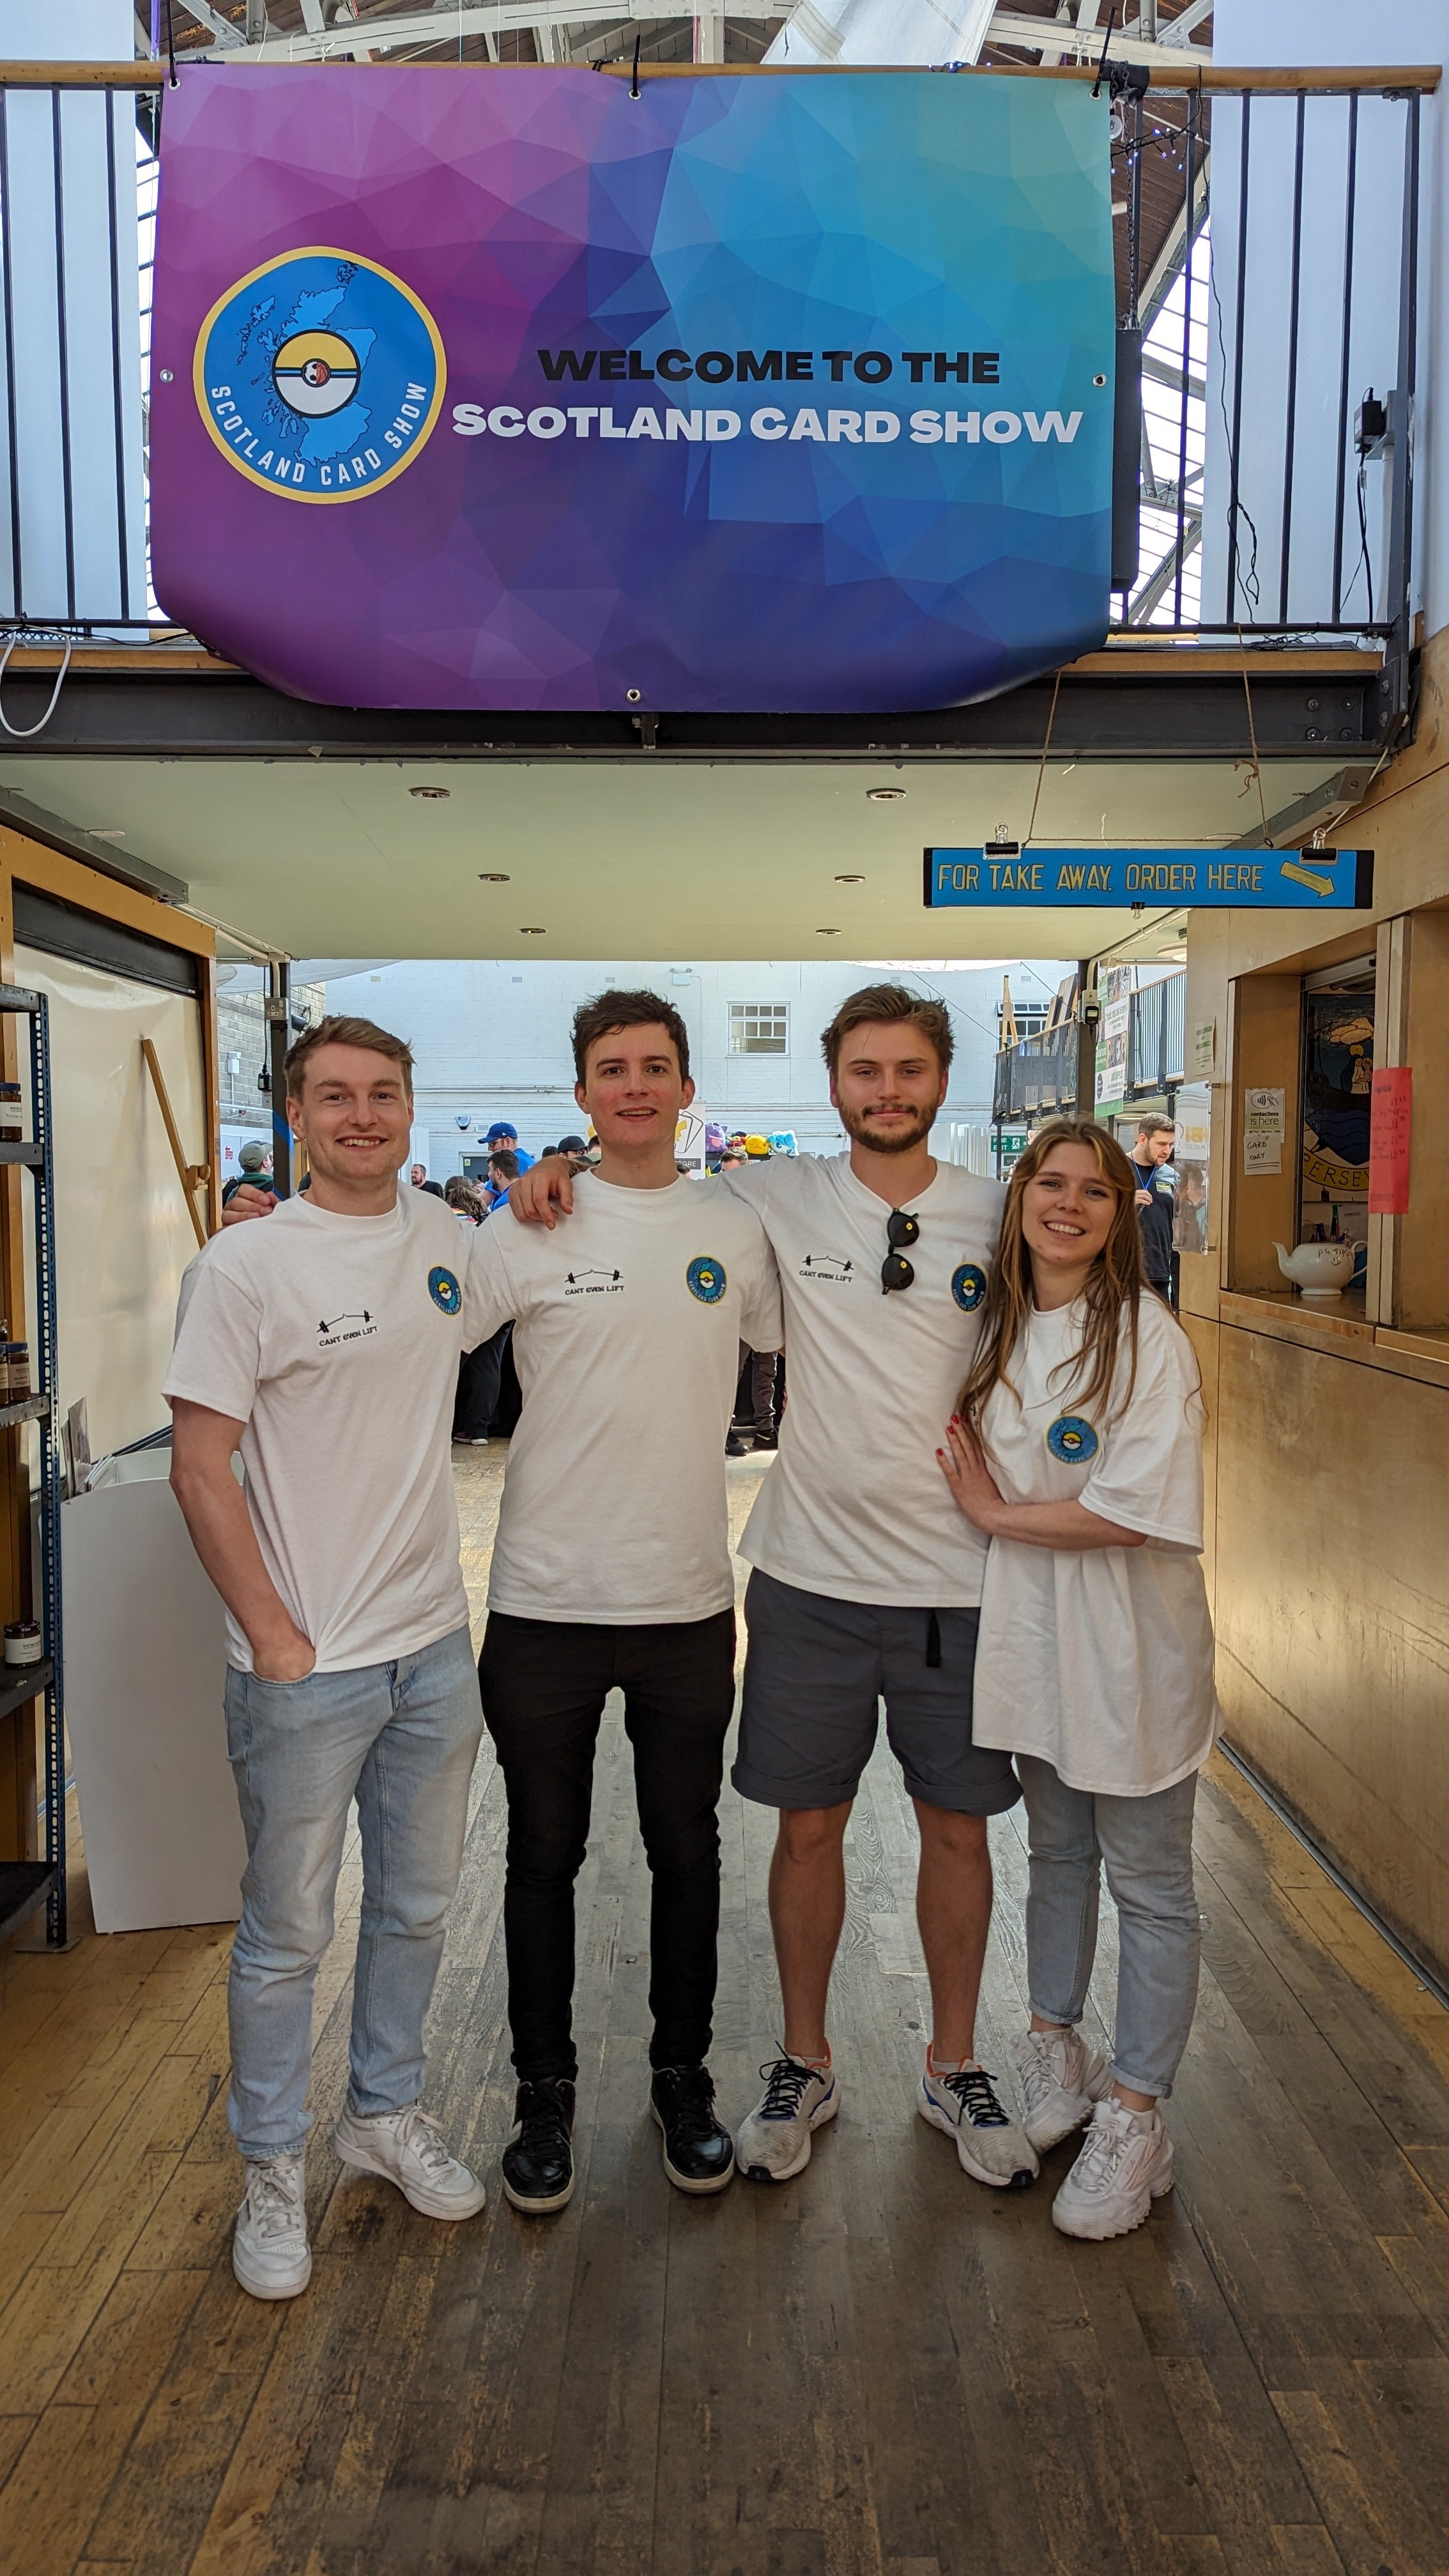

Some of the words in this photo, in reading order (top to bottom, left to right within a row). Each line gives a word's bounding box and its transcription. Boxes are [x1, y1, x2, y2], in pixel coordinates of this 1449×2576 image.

[537, 349, 813, 383] WELCOME
[822, 351, 893, 383] TO
[901, 352, 1000, 383] THE
[211, 386, 305, 483] SCOTLAND
[321, 448, 381, 486] CARD
[384, 382, 427, 448] SHOW
[452, 404, 741, 441] SCOTLAND
[750, 408, 900, 443] CARD
[909, 410, 1083, 443] SHOW
[937, 864, 979, 891] FOR
[989, 864, 1045, 891] TAKE
[1125, 864, 1197, 891] ORDER
[1208, 864, 1265, 892] HERE
[1250, 1117, 1257, 1125] is
[1259, 1116, 1279, 1125] here
[1247, 1141, 1266, 1149] CARD
[1250, 1152, 1265, 1160] ONLY
[319, 1336, 341, 1347] CANT
[362, 1326, 378, 1335] LIFT
